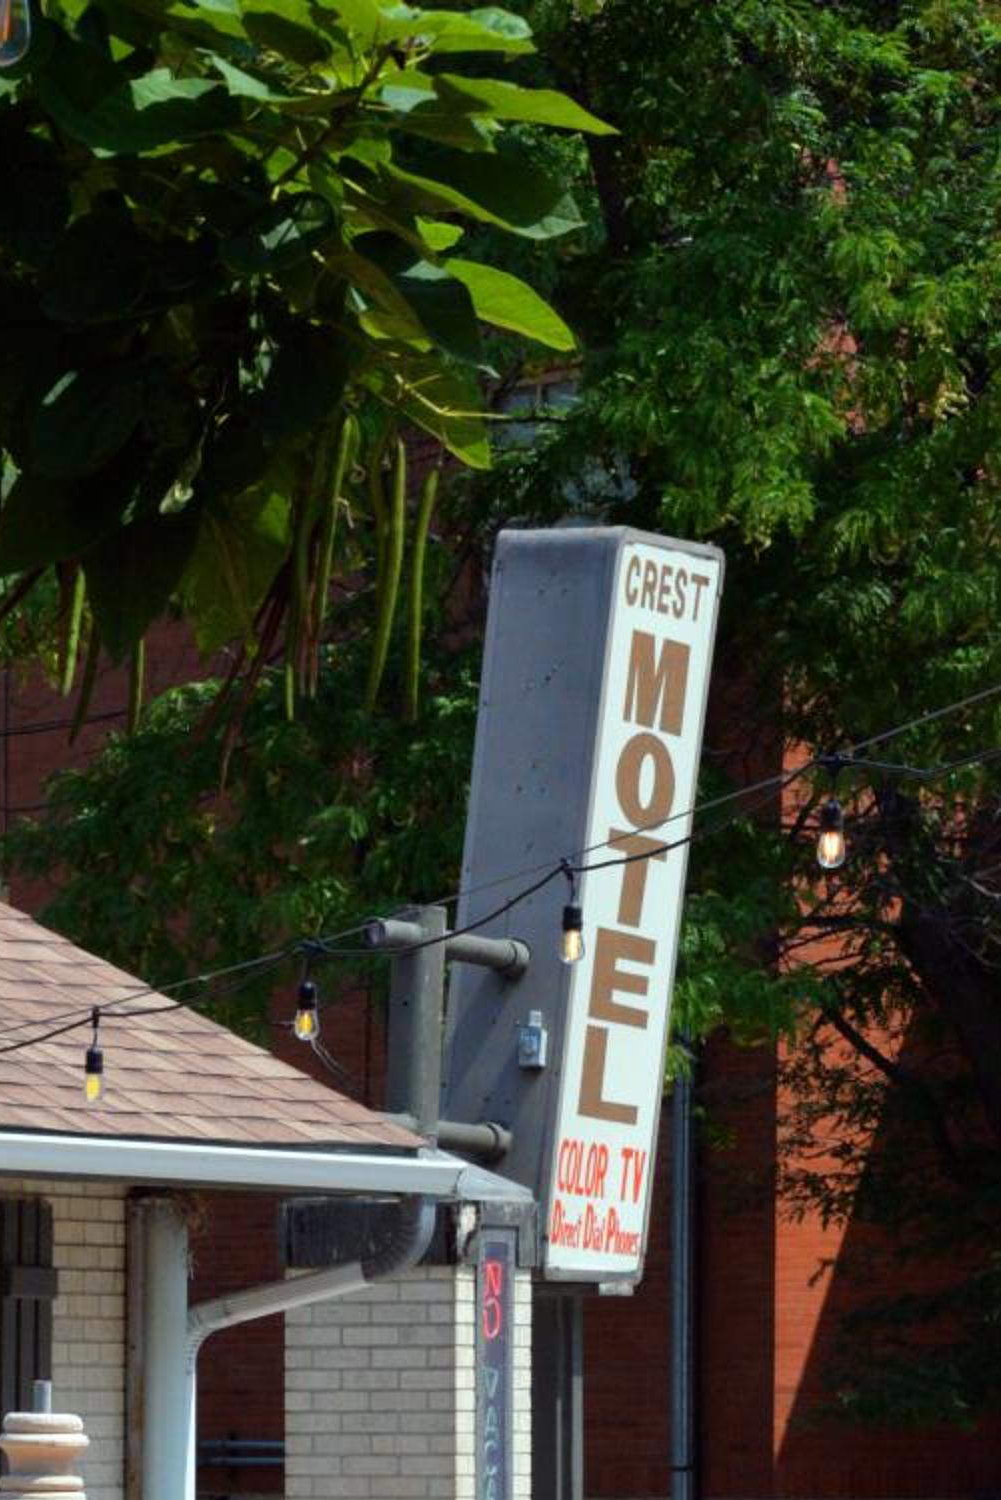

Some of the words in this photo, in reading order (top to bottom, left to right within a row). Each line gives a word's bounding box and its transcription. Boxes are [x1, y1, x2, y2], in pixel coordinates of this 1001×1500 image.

[625, 554, 710, 621] CREST
[577, 630, 690, 1126] MOTEL
[557, 1138, 608, 1199] COLOR
[621, 1147, 647, 1203] TV
[550, 1199, 582, 1249] Direct
[582, 1203, 605, 1251] Dial
[605, 1207, 640, 1256] Phones
[482, 1260, 501, 1339] NO
